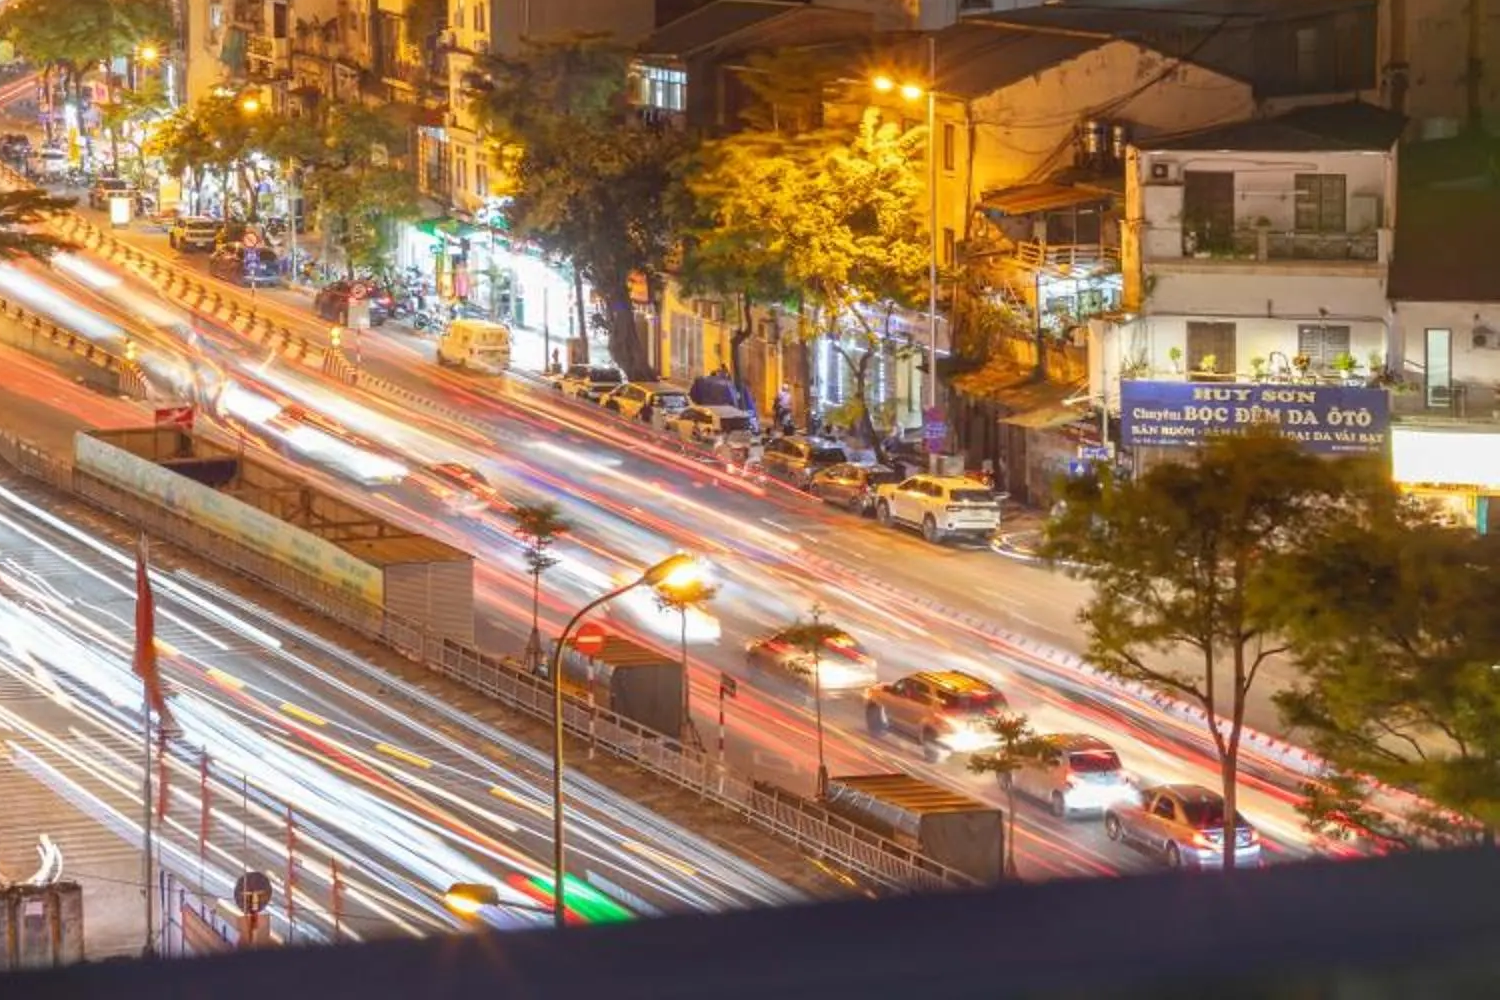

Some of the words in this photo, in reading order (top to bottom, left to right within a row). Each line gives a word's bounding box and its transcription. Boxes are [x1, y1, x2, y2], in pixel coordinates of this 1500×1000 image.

[1194, 387, 1251, 401] HUY
[1184, 405, 1228, 425] BỌC
[1287, 409, 1319, 425] DA
[1326, 406, 1372, 427] ÔTÔ
